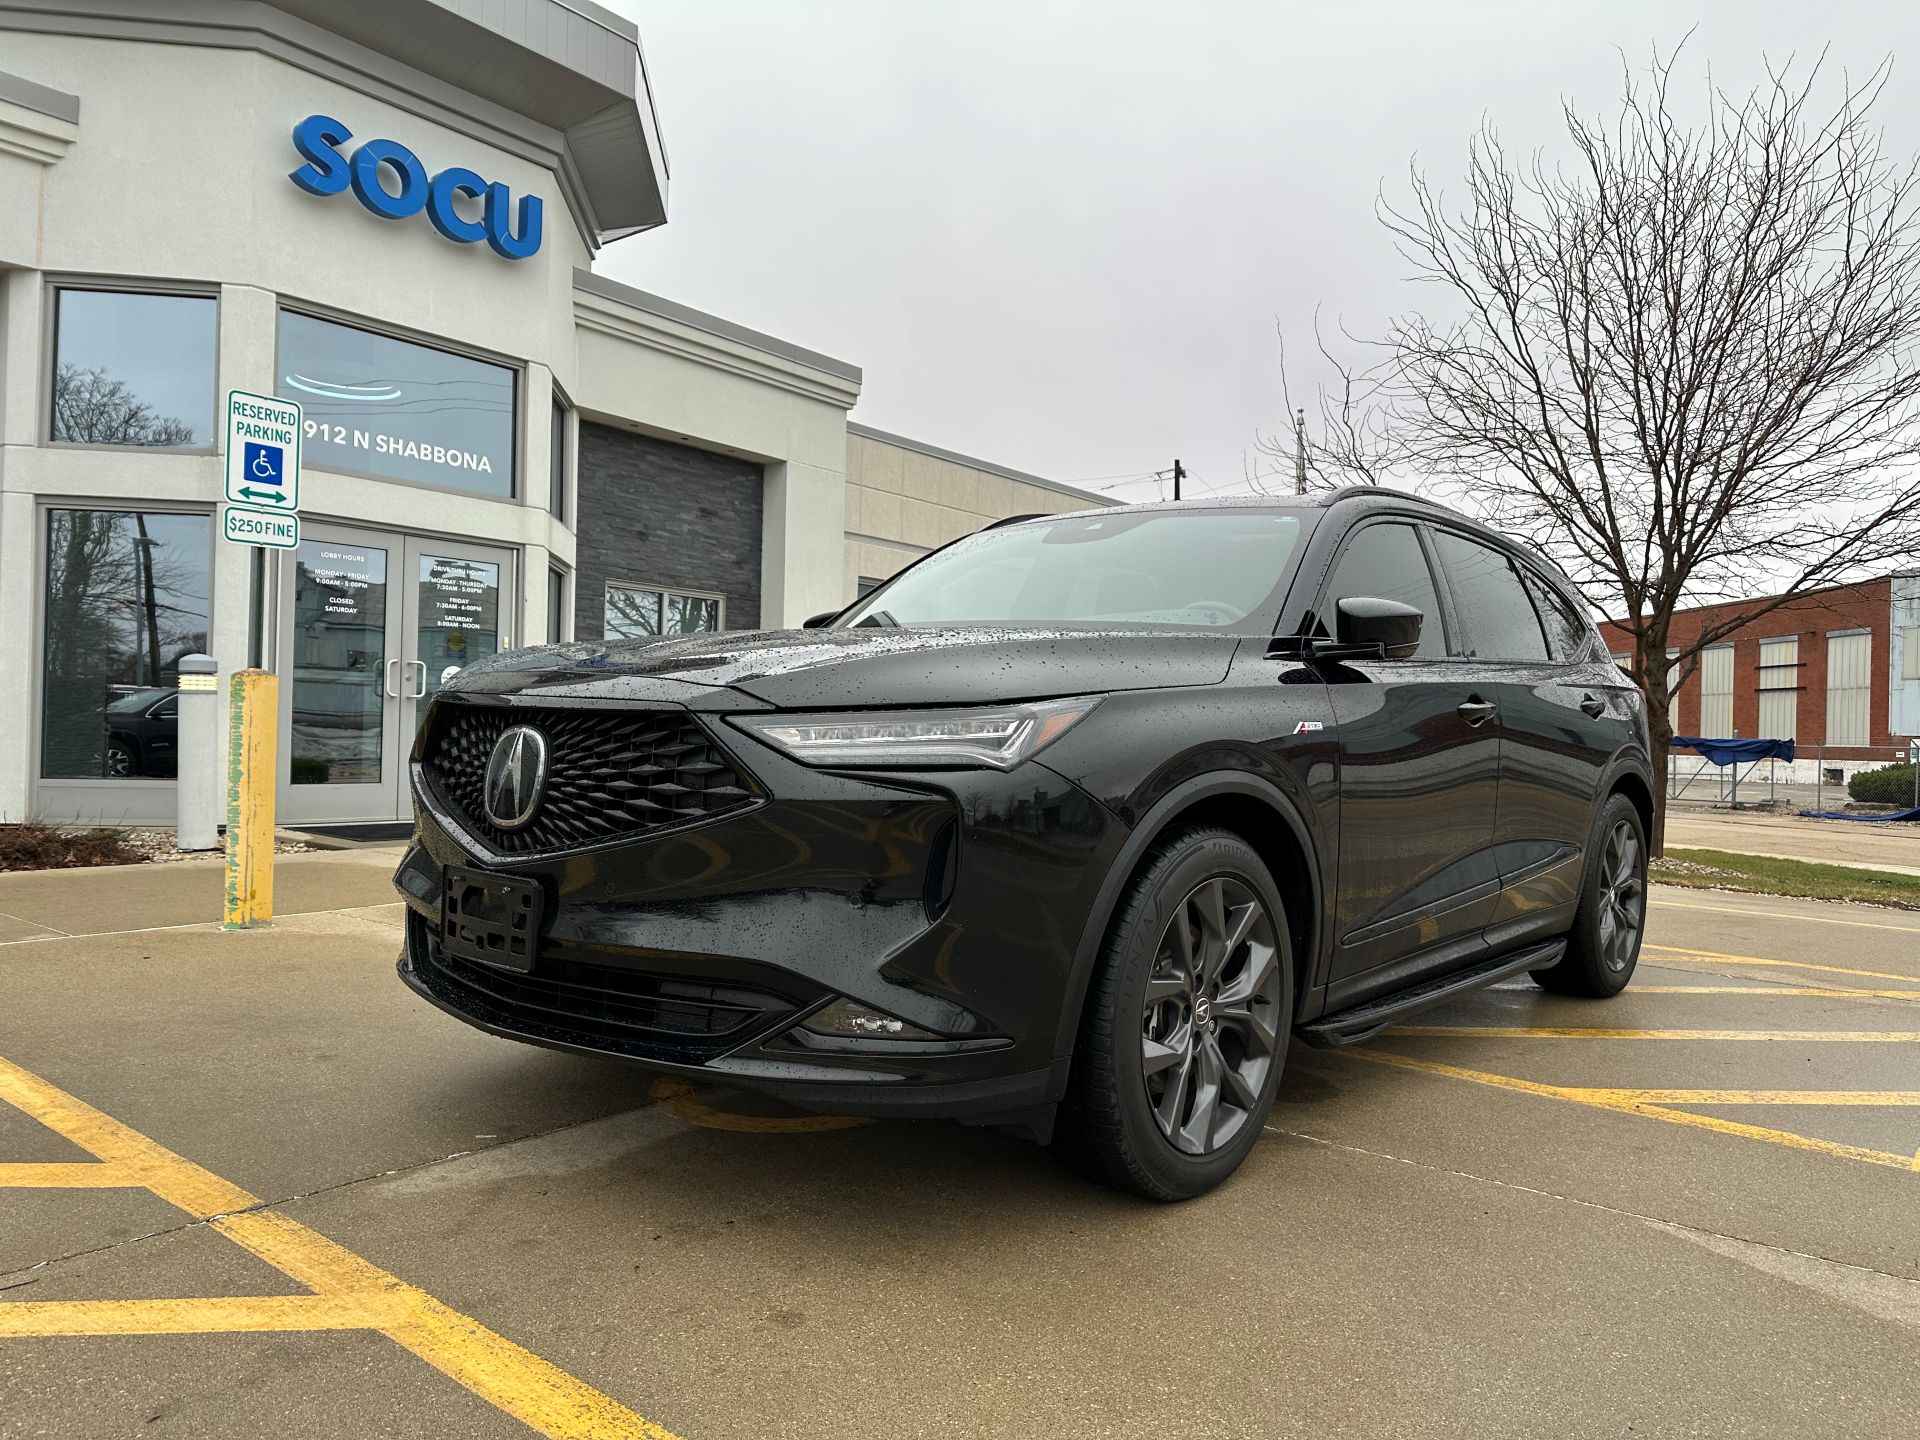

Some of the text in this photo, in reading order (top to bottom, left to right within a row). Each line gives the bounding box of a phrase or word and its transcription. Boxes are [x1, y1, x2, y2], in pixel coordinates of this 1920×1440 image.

[287, 114, 543, 260] SOCU
[233, 401, 296, 426] RESERVED
[236, 421, 292, 445] PARKING
[303, 420, 492, 474] 912 N SHABBONA
[229, 516, 293, 538] $250 FINE
[314, 569, 344, 577] MONDAY
[347, 572, 370, 580] FRIDAY
[467, 569, 486, 577] HOURS
[315, 578, 340, 586] 9:00AM
[344, 581, 368, 589] 5:00PM
[431, 577, 457, 585] MONDAY
[459, 580, 488, 589] THURSDAY
[329, 597, 354, 605] CLOSED
[436, 602, 458, 610] 7:30AM
[325, 605, 358, 613] SATURDAY
